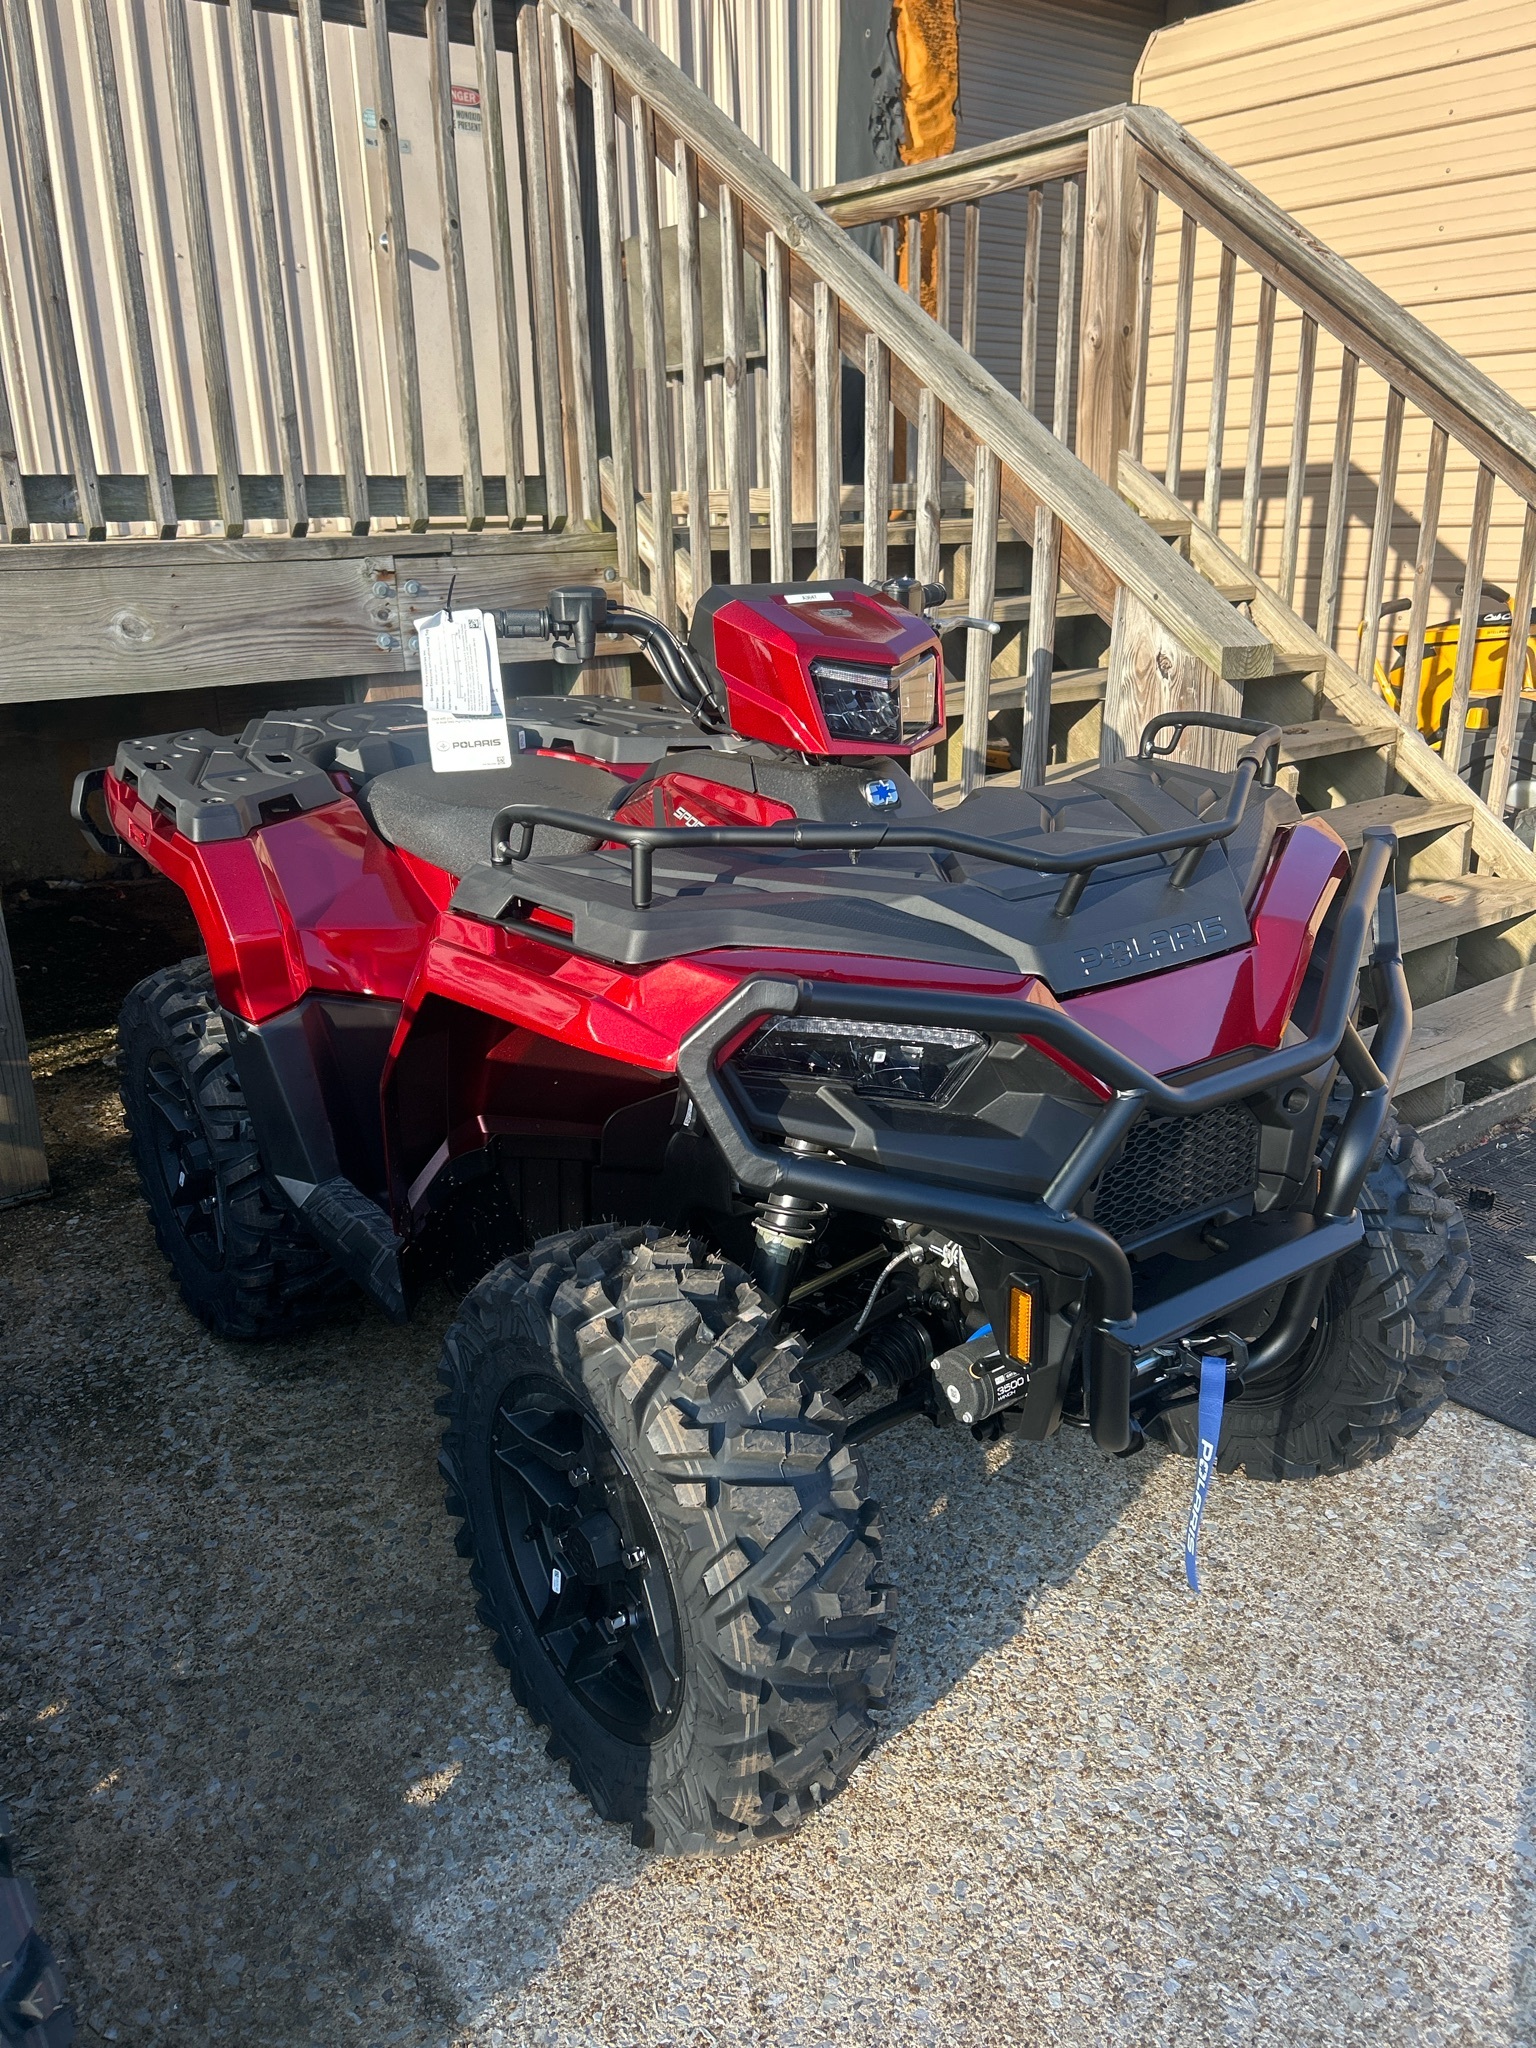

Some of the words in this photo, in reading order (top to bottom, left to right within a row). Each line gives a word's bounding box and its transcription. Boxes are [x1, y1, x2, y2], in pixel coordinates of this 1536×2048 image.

[452, 90, 476, 103] NGER
[456, 110, 480, 121] MONOXID
[452, 739, 501, 749] POLARIS
[1073, 915, 1228, 977] POLARIS
[997, 1377, 1024, 1396] 3500
[998, 1390, 1016, 1402] WINCH
[1187, 1438, 1214, 1556] POLARIS
